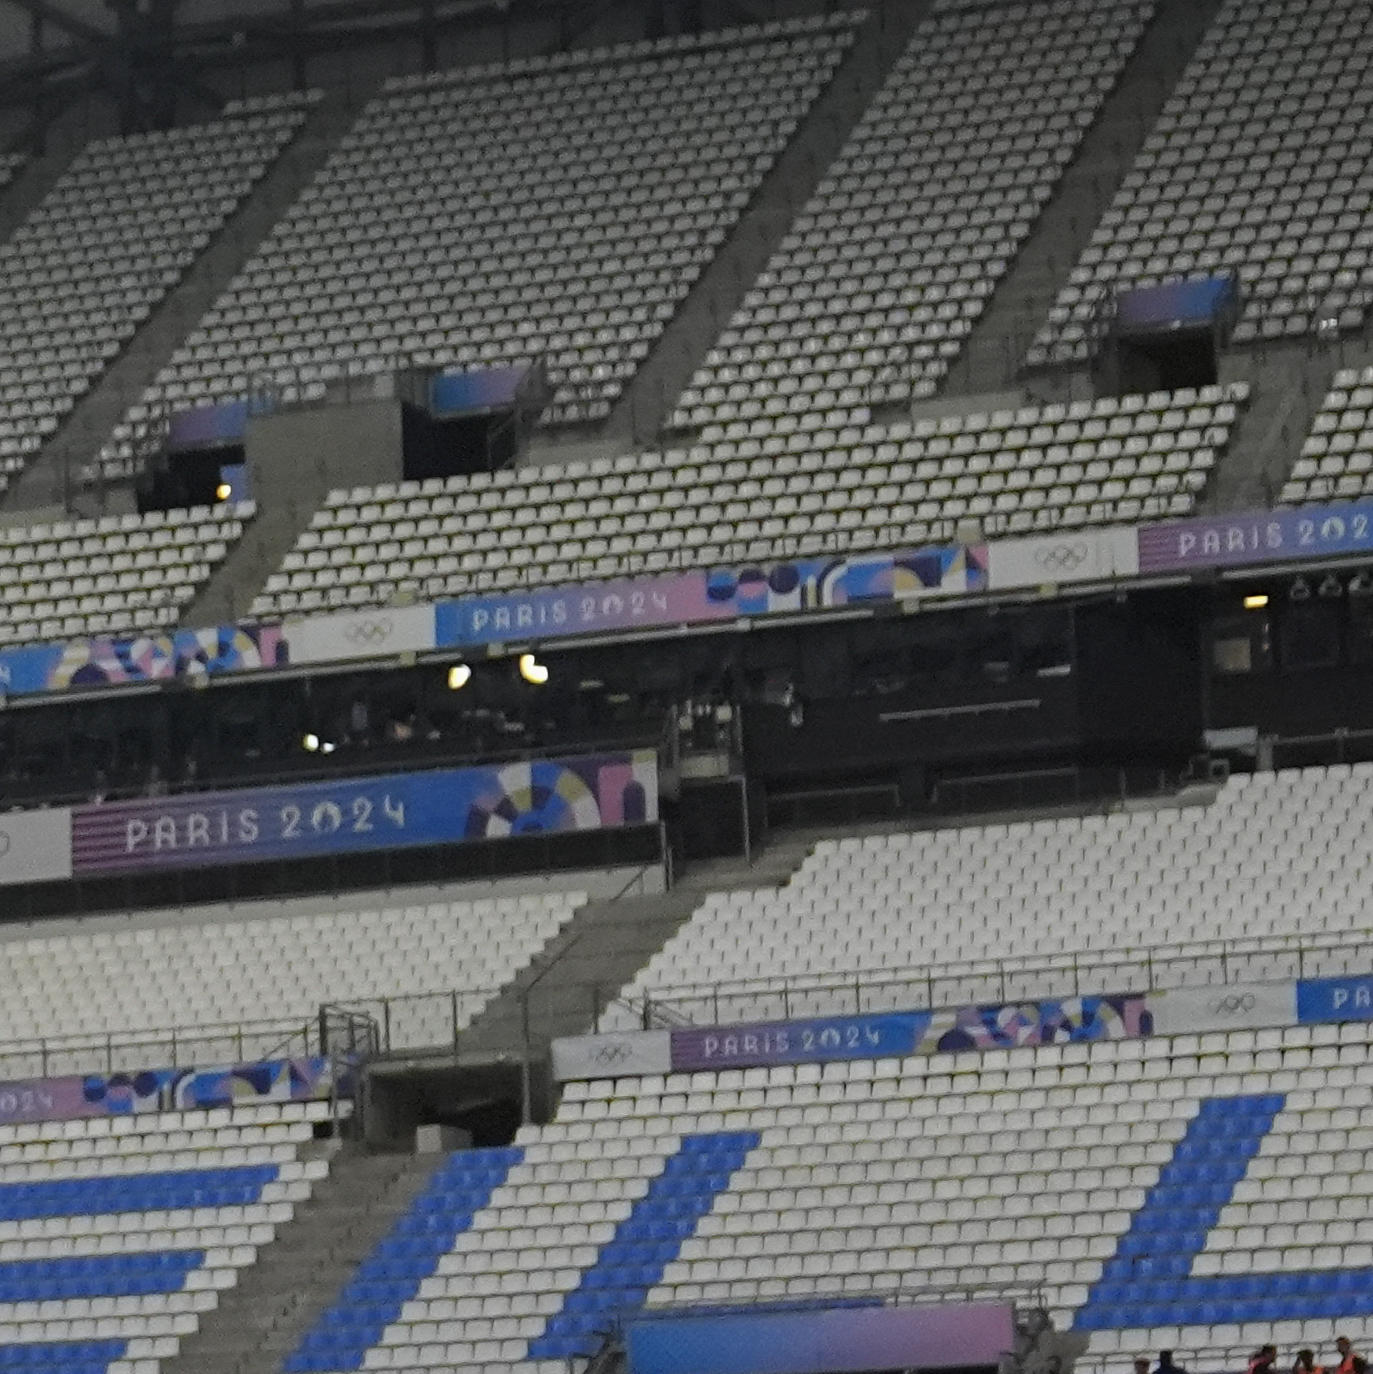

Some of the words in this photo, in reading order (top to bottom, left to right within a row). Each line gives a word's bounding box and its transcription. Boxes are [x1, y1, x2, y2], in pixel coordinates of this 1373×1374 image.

[1179, 521, 1283, 558] PARIS
[472, 600, 567, 632] PARIS
[581, 591, 668, 621] 2024
[125, 809, 259, 853] PARIS
[279, 794, 405, 839] 2024
[704, 1030, 790, 1059] PARIS
[802, 1025, 881, 1053] 2024
